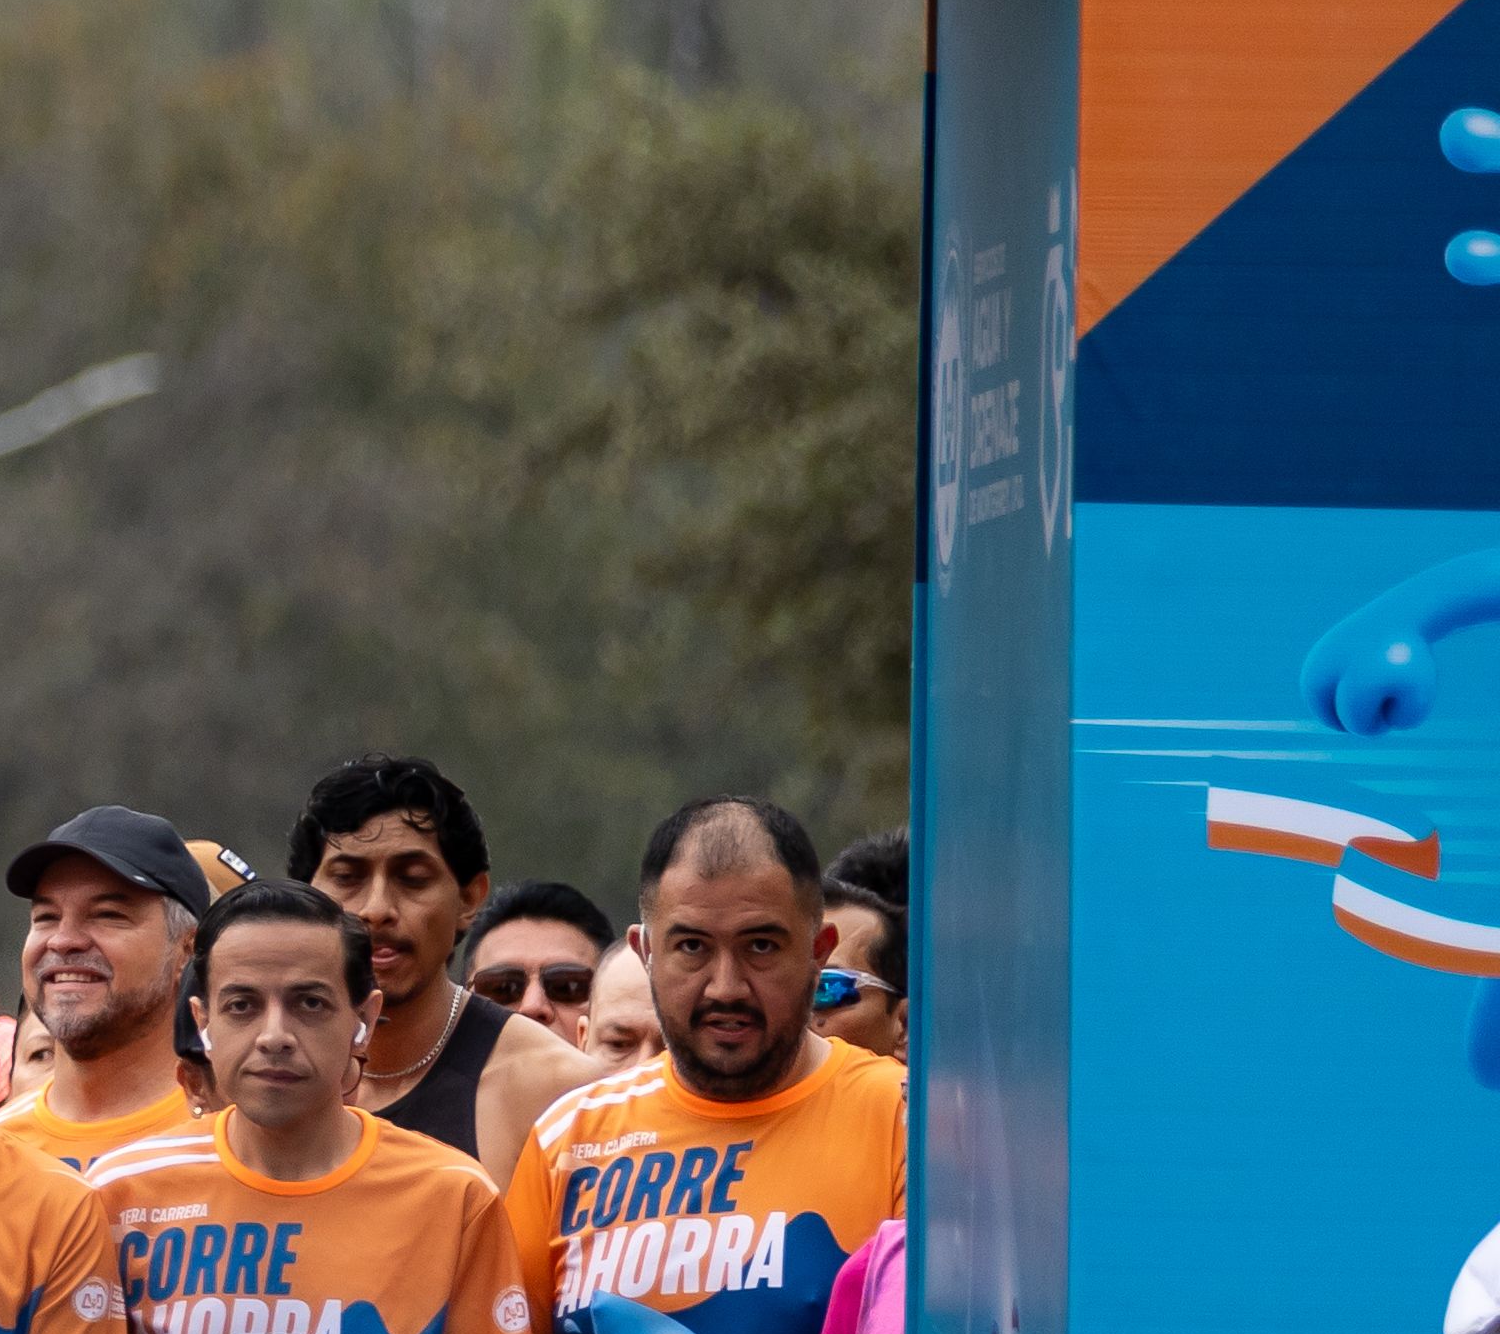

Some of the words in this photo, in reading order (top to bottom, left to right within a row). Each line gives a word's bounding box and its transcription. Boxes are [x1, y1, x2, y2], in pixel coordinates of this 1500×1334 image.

[149, 1203, 209, 1224] CARRERA
[560, 1140, 753, 1237] CORRE
[118, 1222, 302, 1307] CORRE
[557, 1211, 787, 1319] AHORRA
